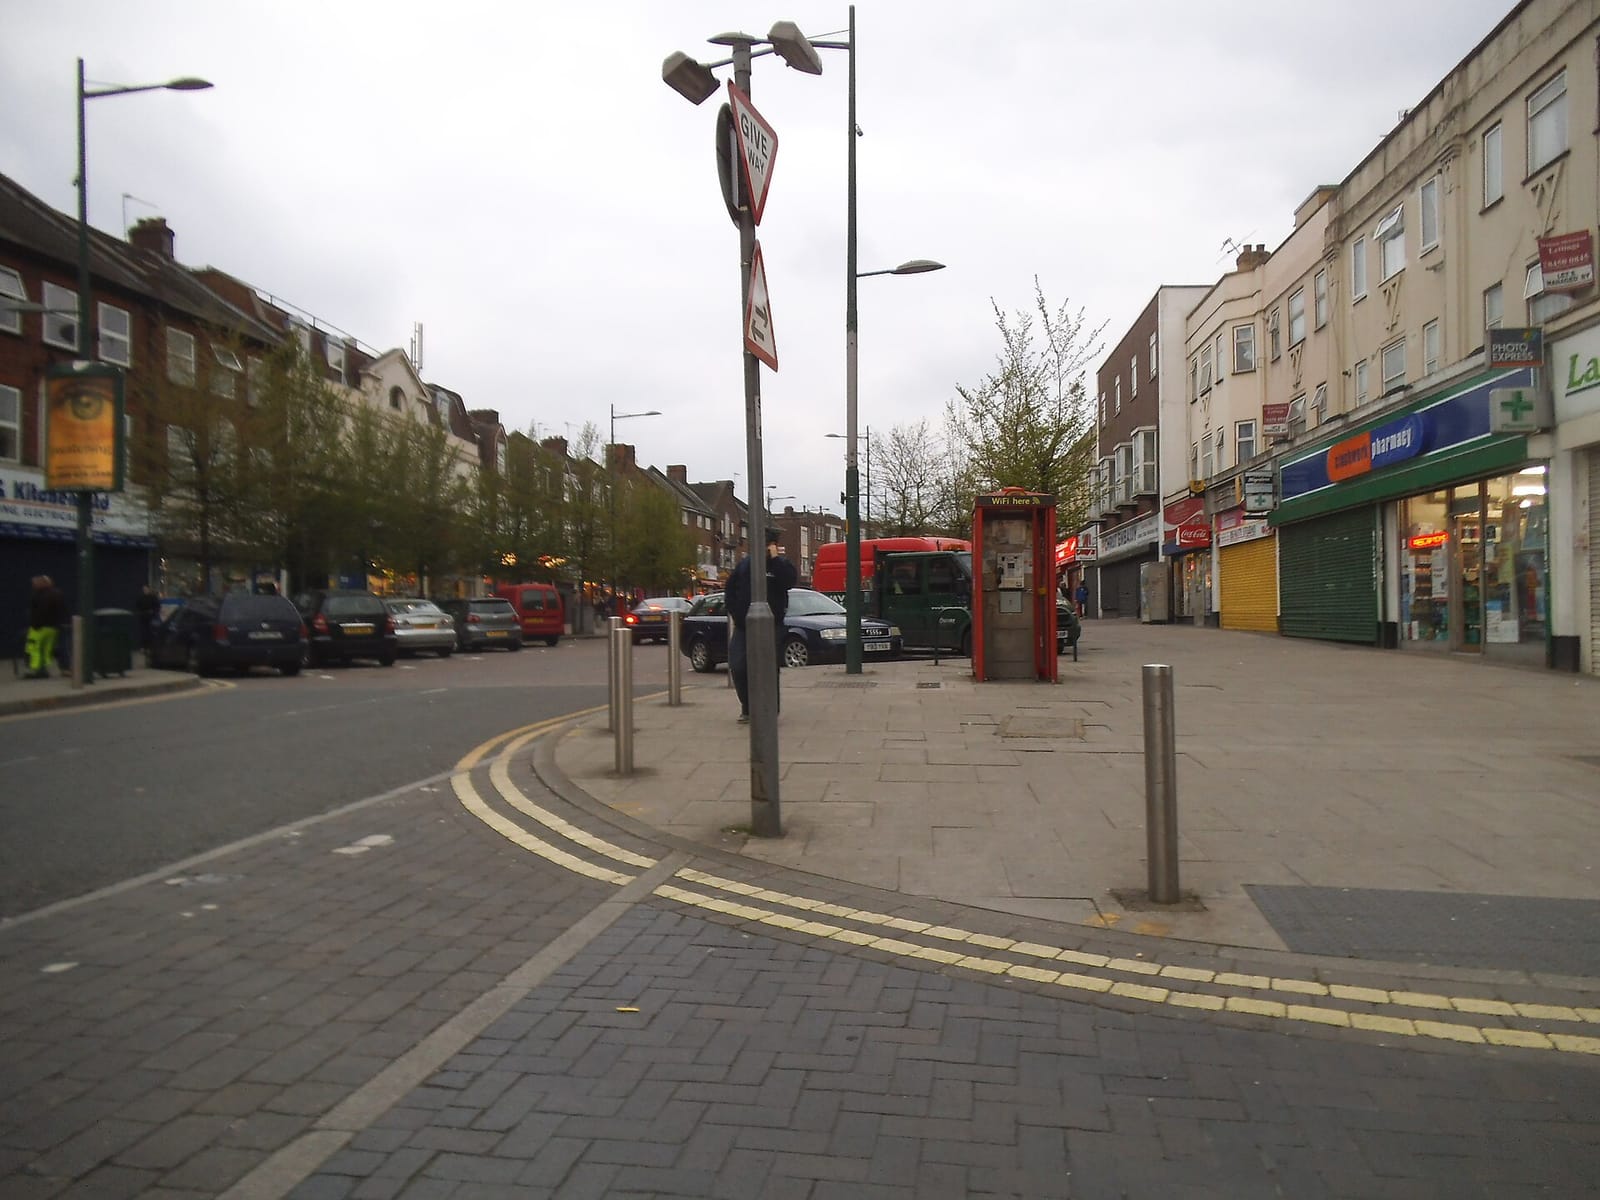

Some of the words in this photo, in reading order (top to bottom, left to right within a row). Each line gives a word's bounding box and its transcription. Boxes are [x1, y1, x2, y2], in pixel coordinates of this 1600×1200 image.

[741, 112, 768, 160] GIVE
[747, 146, 765, 176] WAY
[1492, 343, 1529, 353] PHOTO
[1492, 352, 1534, 361] EXPRESS
[1371, 427, 1412, 460] pharmacy
[991, 497, 1010, 505] WiFi
[1012, 497, 1031, 505] here
